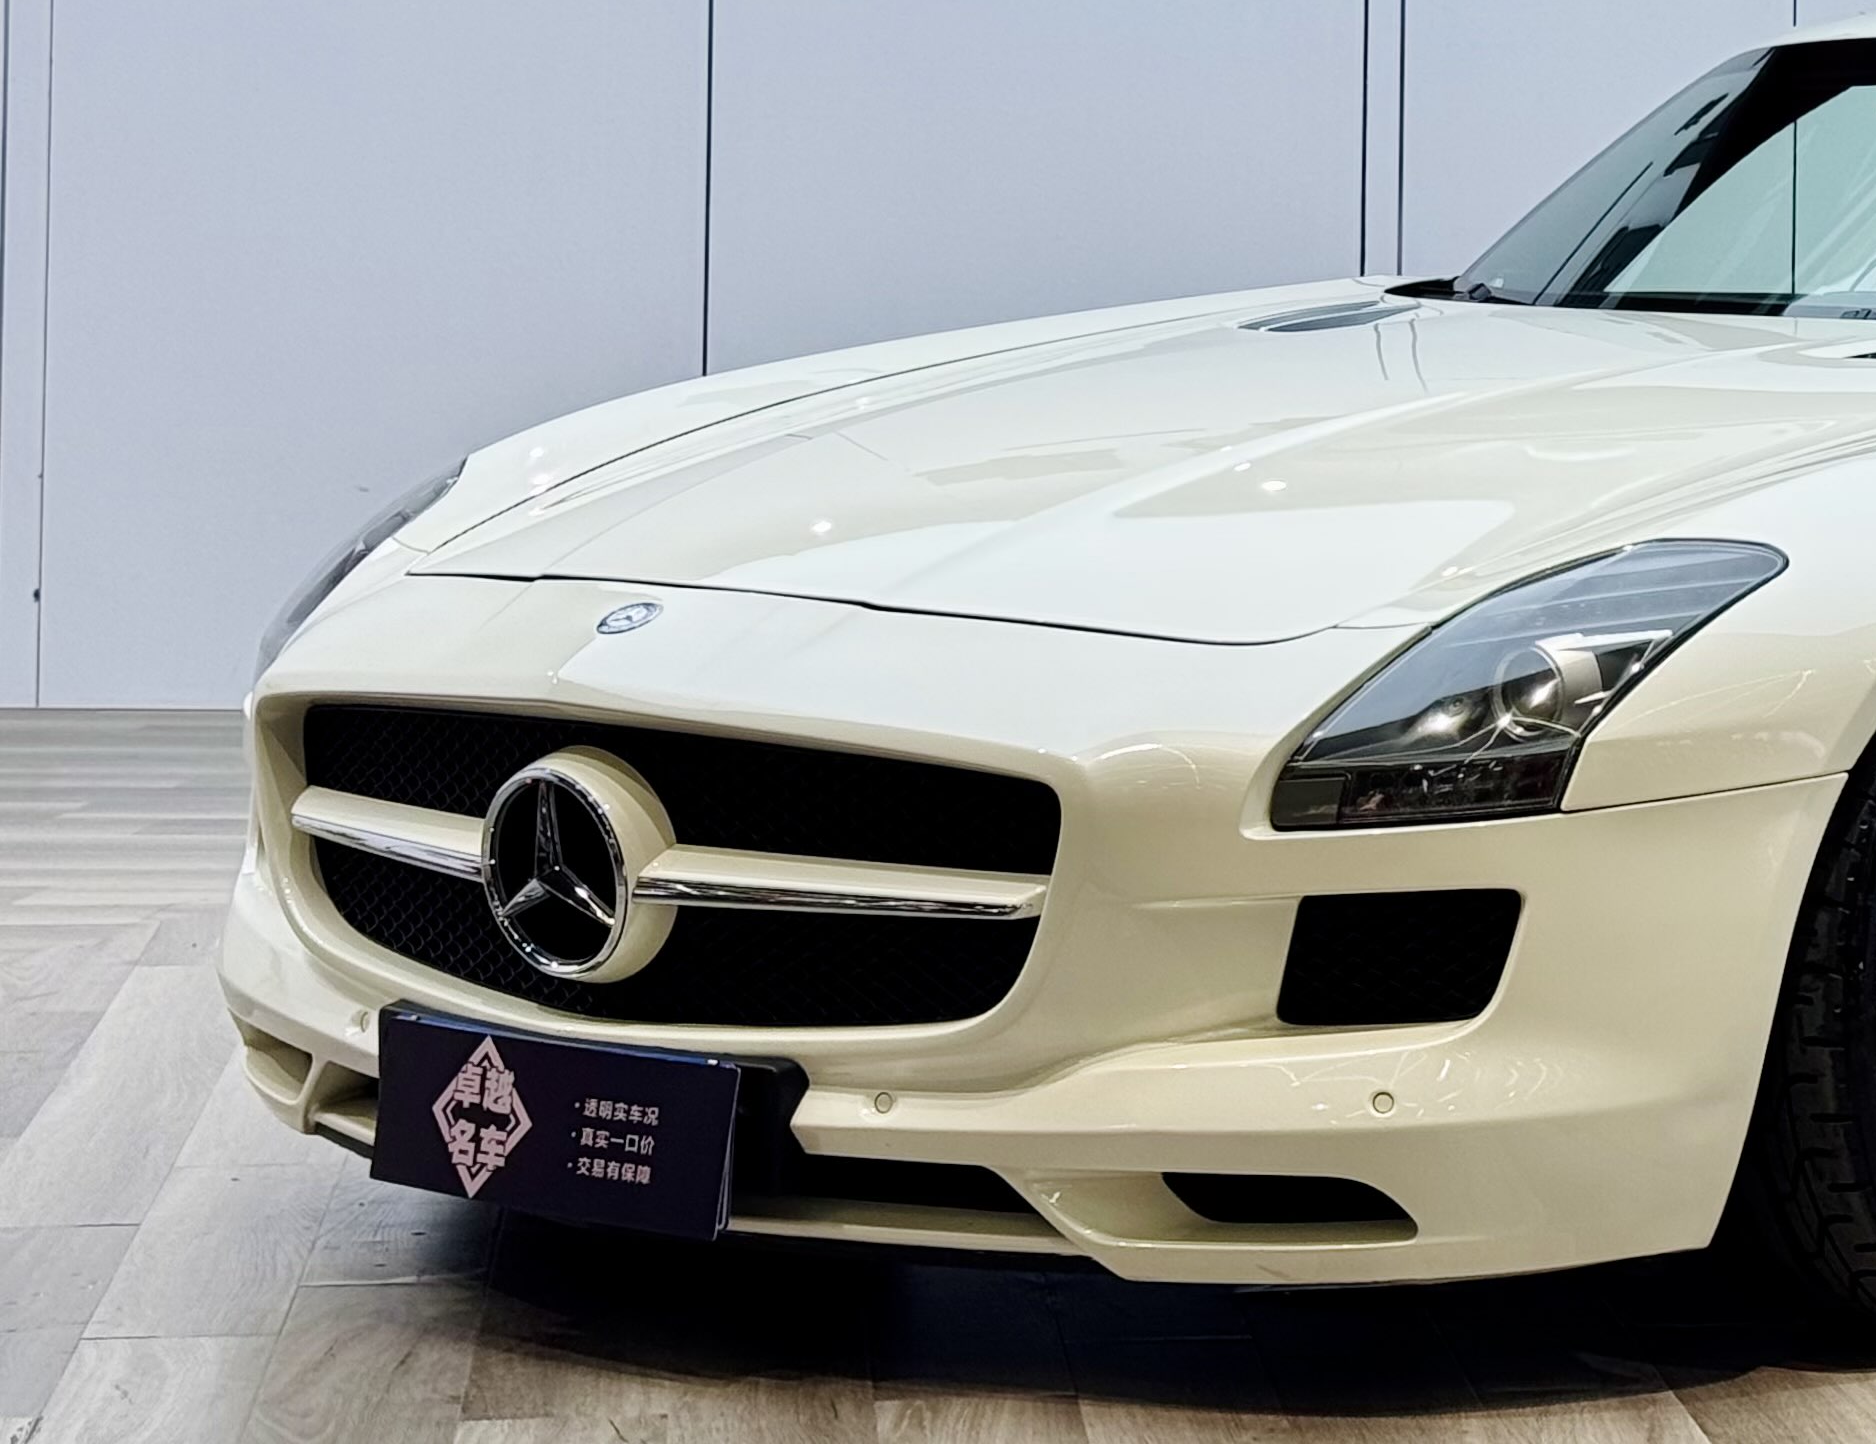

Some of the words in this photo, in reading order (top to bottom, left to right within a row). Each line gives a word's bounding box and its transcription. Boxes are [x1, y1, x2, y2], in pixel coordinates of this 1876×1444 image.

[453, 1063, 515, 1115] 卓越
[448, 1119, 507, 1171] 名车
[580, 1127, 655, 1156] 真实一口价
[576, 1157, 651, 1185] 交易有保障
